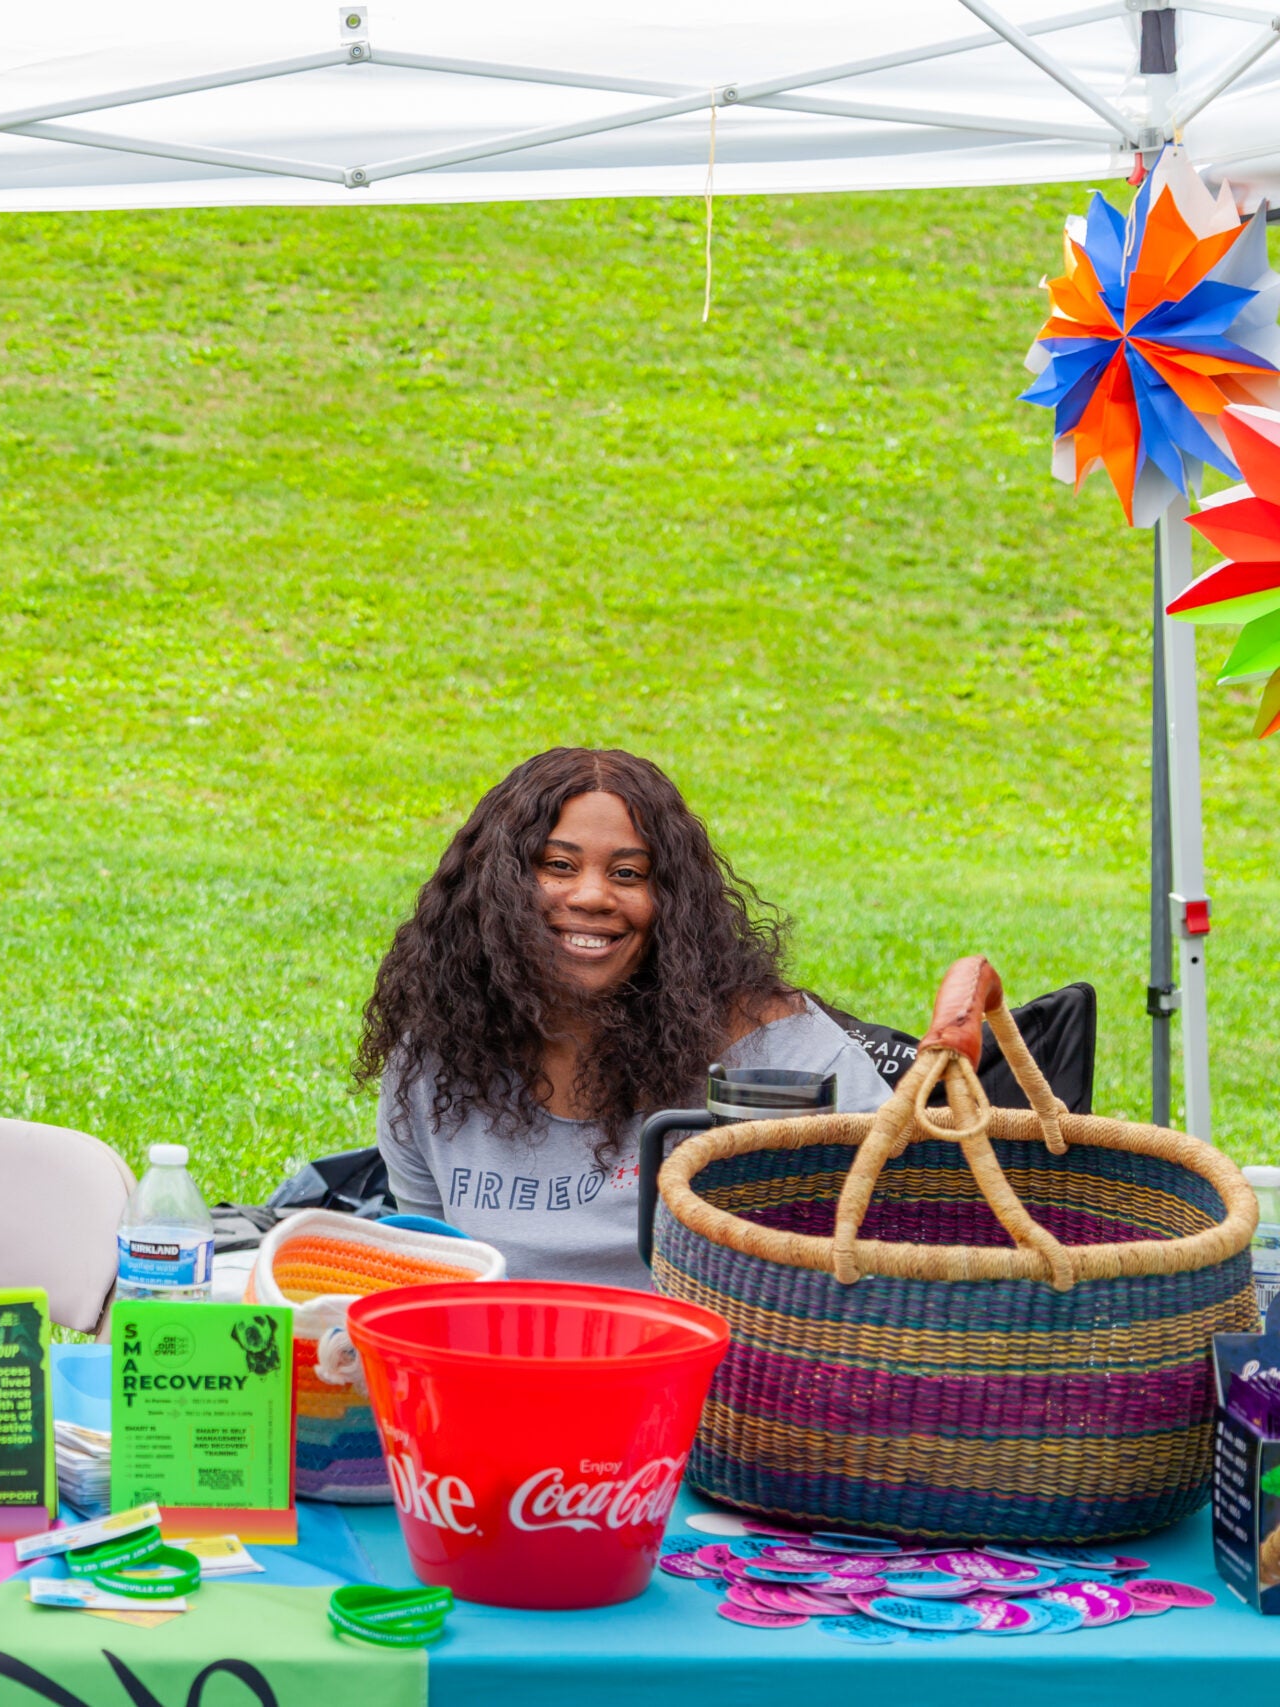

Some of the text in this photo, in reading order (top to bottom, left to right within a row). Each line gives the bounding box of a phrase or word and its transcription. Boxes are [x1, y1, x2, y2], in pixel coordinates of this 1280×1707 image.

[131, 1243, 178, 1255] KIRKLAND
[123, 1323, 142, 1407] SMART
[0, 1377, 31, 1388] lived
[16, 1400, 31, 1410] all
[18, 1410, 32, 1421] of
[580, 1459, 622, 1477] Enjoy
[387, 1453, 478, 1535] oke
